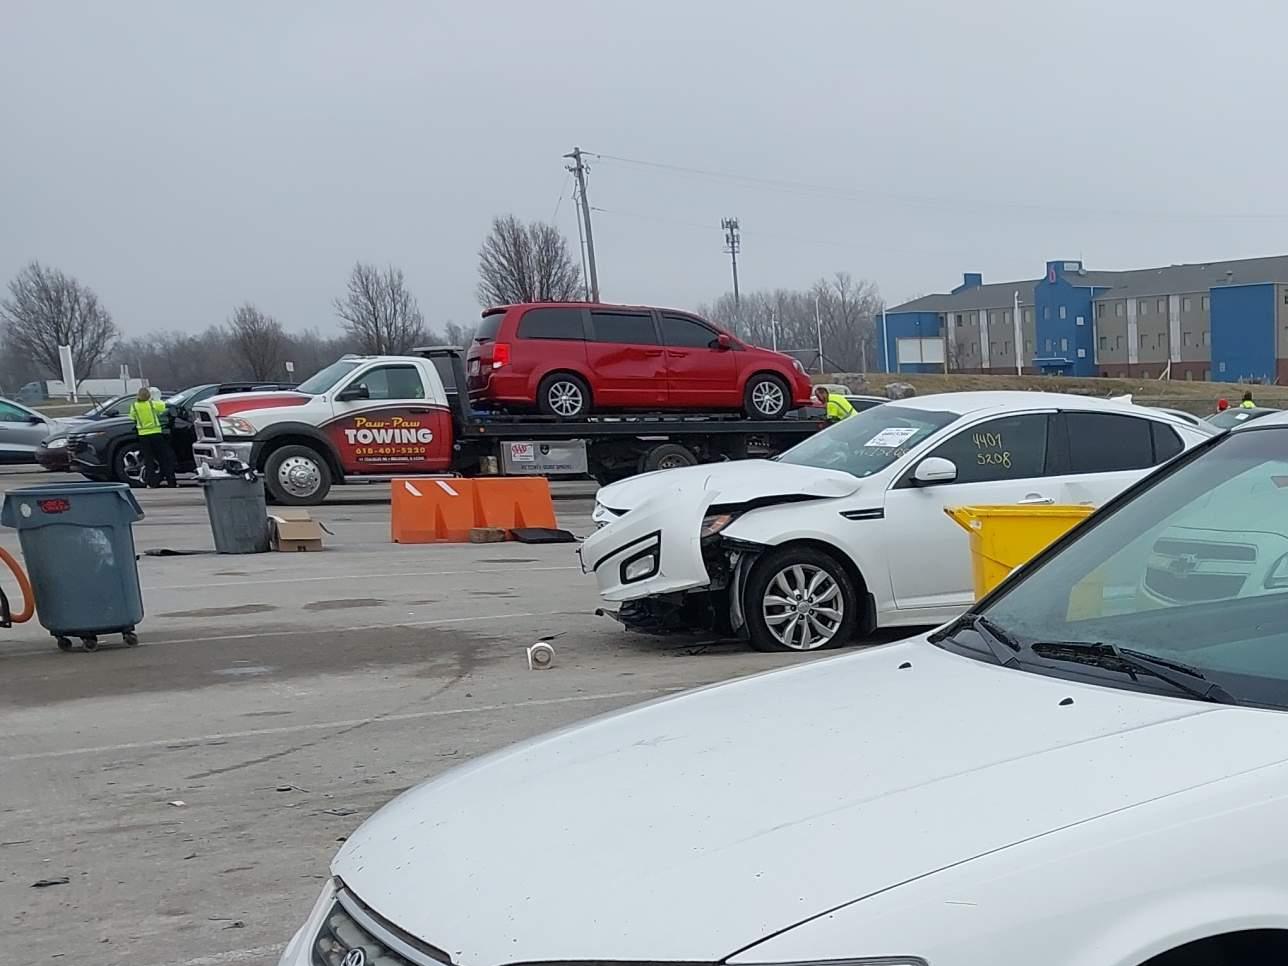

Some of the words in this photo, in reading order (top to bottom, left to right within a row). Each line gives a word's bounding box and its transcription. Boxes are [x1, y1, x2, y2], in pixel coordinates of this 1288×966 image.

[354, 417, 420, 428] Paw-Paw
[345, 428, 433, 444] TOWING
[976, 452, 1012, 469] 5208
